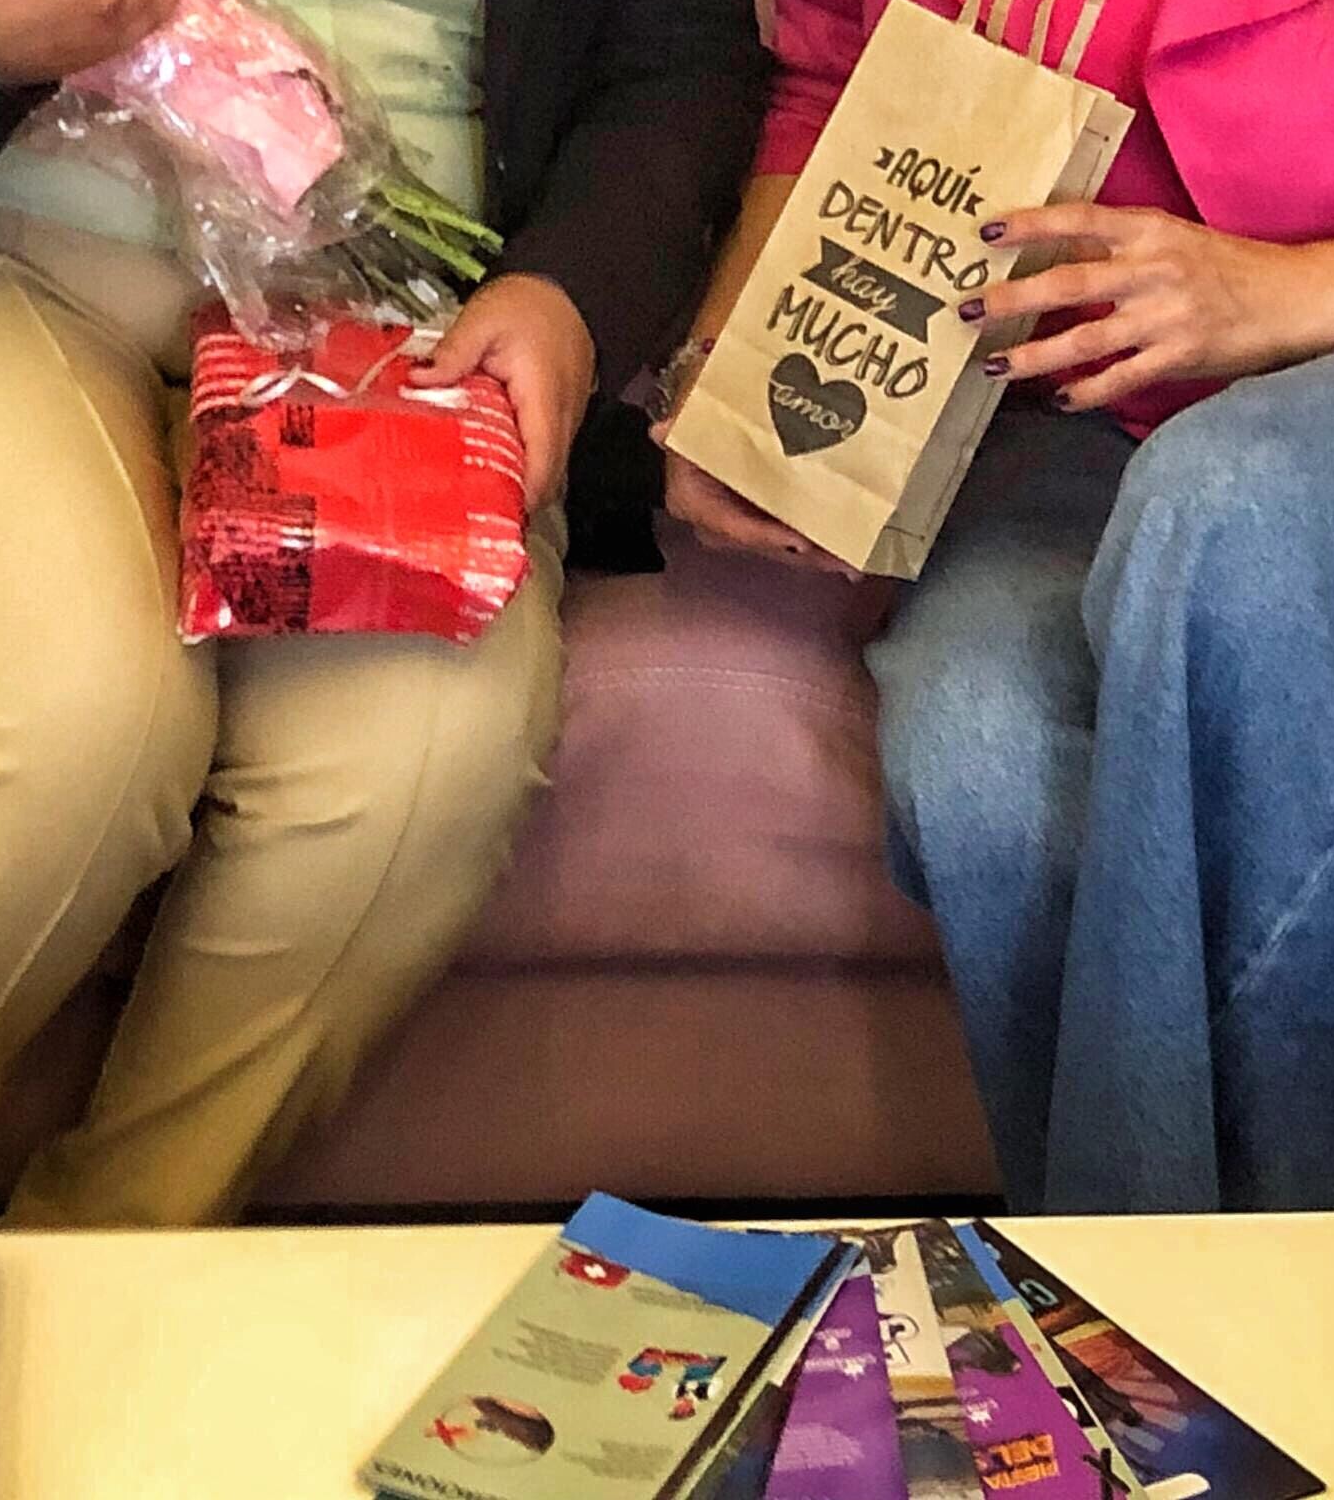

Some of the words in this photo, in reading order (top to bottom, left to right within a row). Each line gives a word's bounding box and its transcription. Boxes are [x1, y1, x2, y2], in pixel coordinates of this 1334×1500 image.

[817, 179, 989, 291] DENTRO
[830, 254, 898, 315] hay
[767, 284, 929, 398] MUCHO
[769, 380, 855, 438] amor
